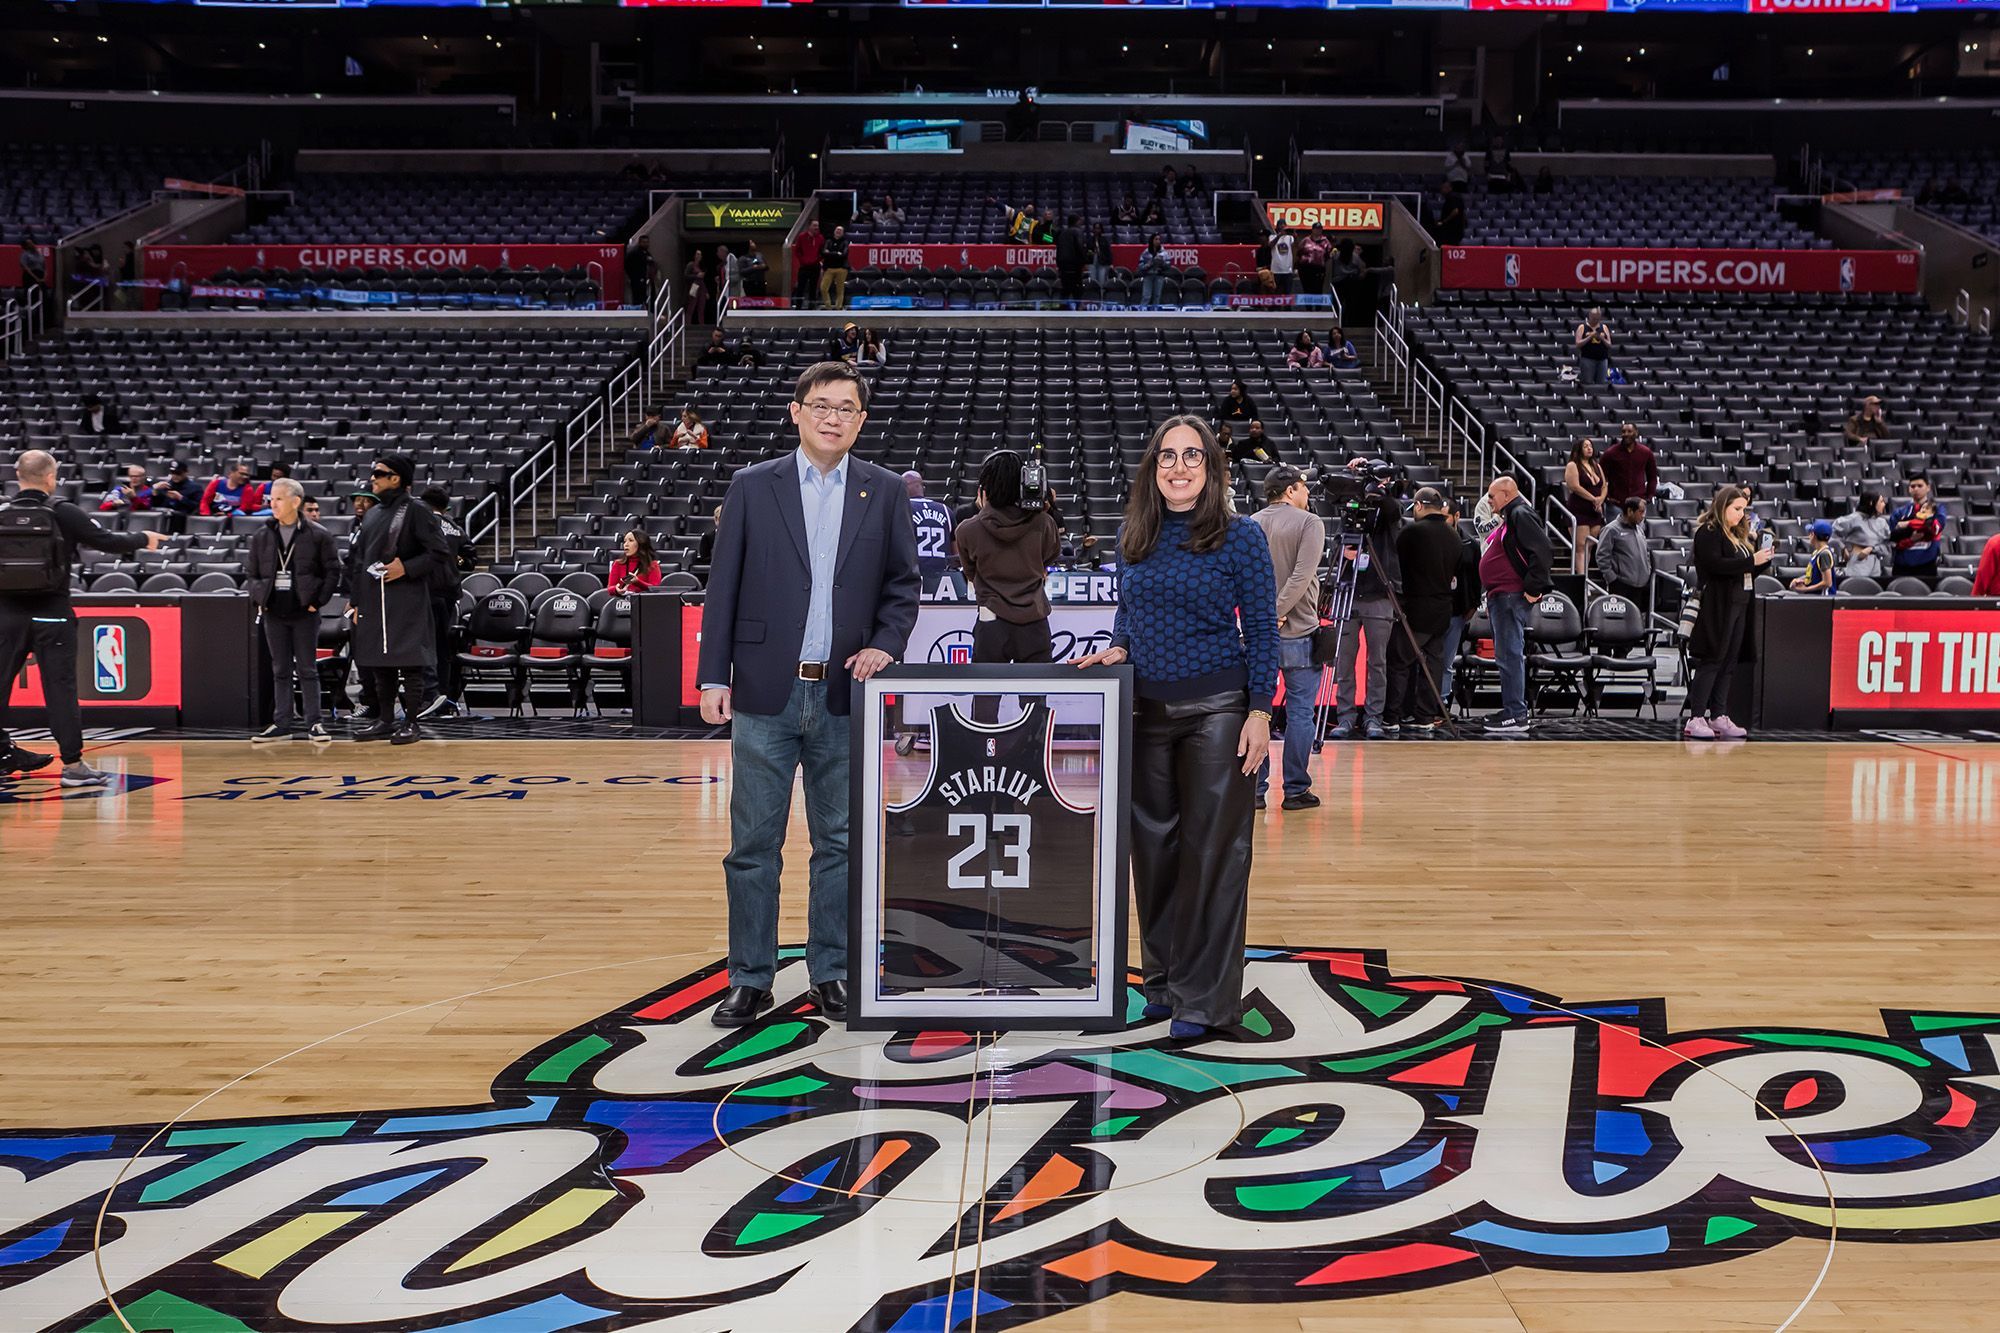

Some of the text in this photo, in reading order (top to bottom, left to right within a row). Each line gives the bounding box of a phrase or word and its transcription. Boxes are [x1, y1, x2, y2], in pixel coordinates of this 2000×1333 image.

[1269, 207, 1380, 229] TOSHIBA
[149, 250, 168, 259] 119
[298, 248, 467, 267] CLIPPERS.COM
[599, 248, 618, 258] 119
[880, 248, 923, 265] CLIPPERS
[1447, 250, 1466, 260] 102
[1896, 253, 1915, 264] 102
[1575, 258, 1785, 285] CLIPPERS.COM
[912, 508, 947, 526] DJ DENSE
[917, 526, 946, 558] 22
[488, 599, 512, 610] CLIPPERS
[553, 599, 578, 611] CLIPPERS
[1540, 601, 1564, 613] CLIPPERS
[1603, 601, 1627, 613] CLIPPERS
[1857, 631, 1930, 693] GET
[222, 775, 725, 787] crypto.co
[938, 765, 1042, 806] STARLUX
[177, 789, 532, 800] ARENA
[947, 813, 1032, 889] 23
